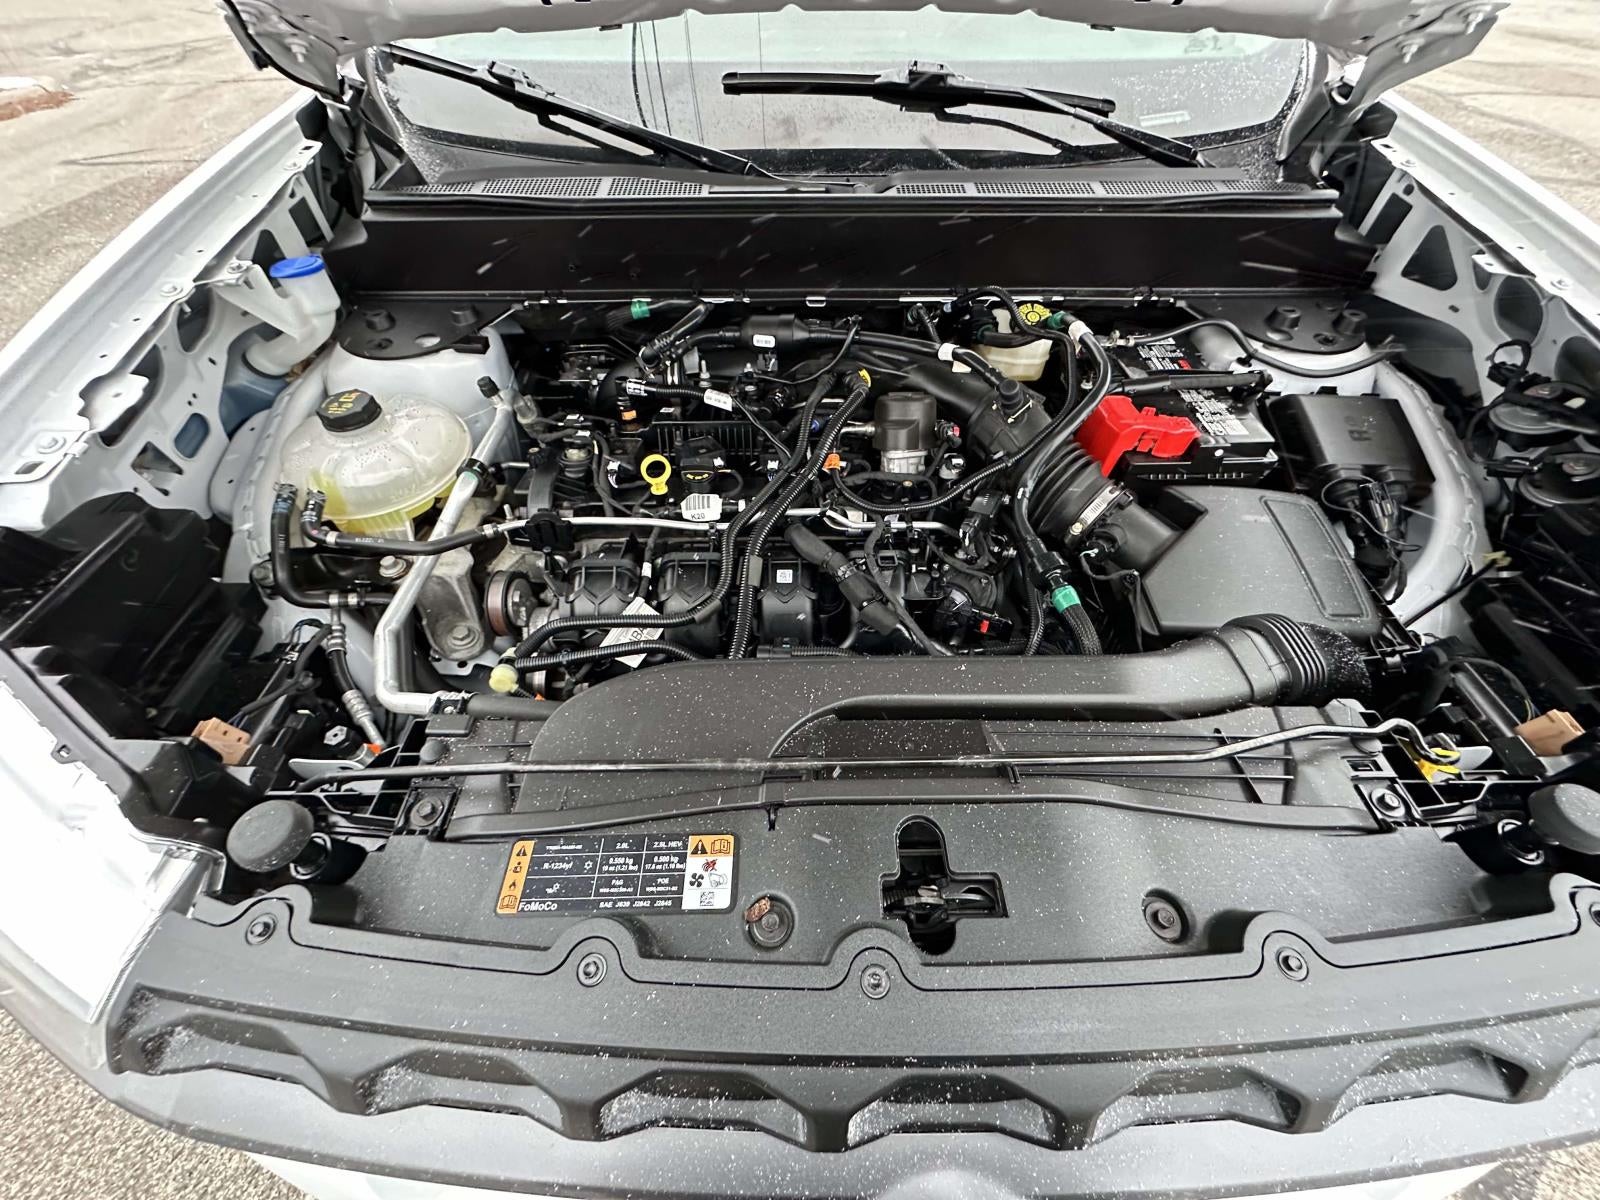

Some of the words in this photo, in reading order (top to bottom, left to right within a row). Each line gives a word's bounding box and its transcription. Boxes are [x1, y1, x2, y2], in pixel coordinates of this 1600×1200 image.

[668, 840, 683, 848] HEV
[543, 861, 573, 871] R-1234yf
[518, 901, 558, 911] FoMoCo
